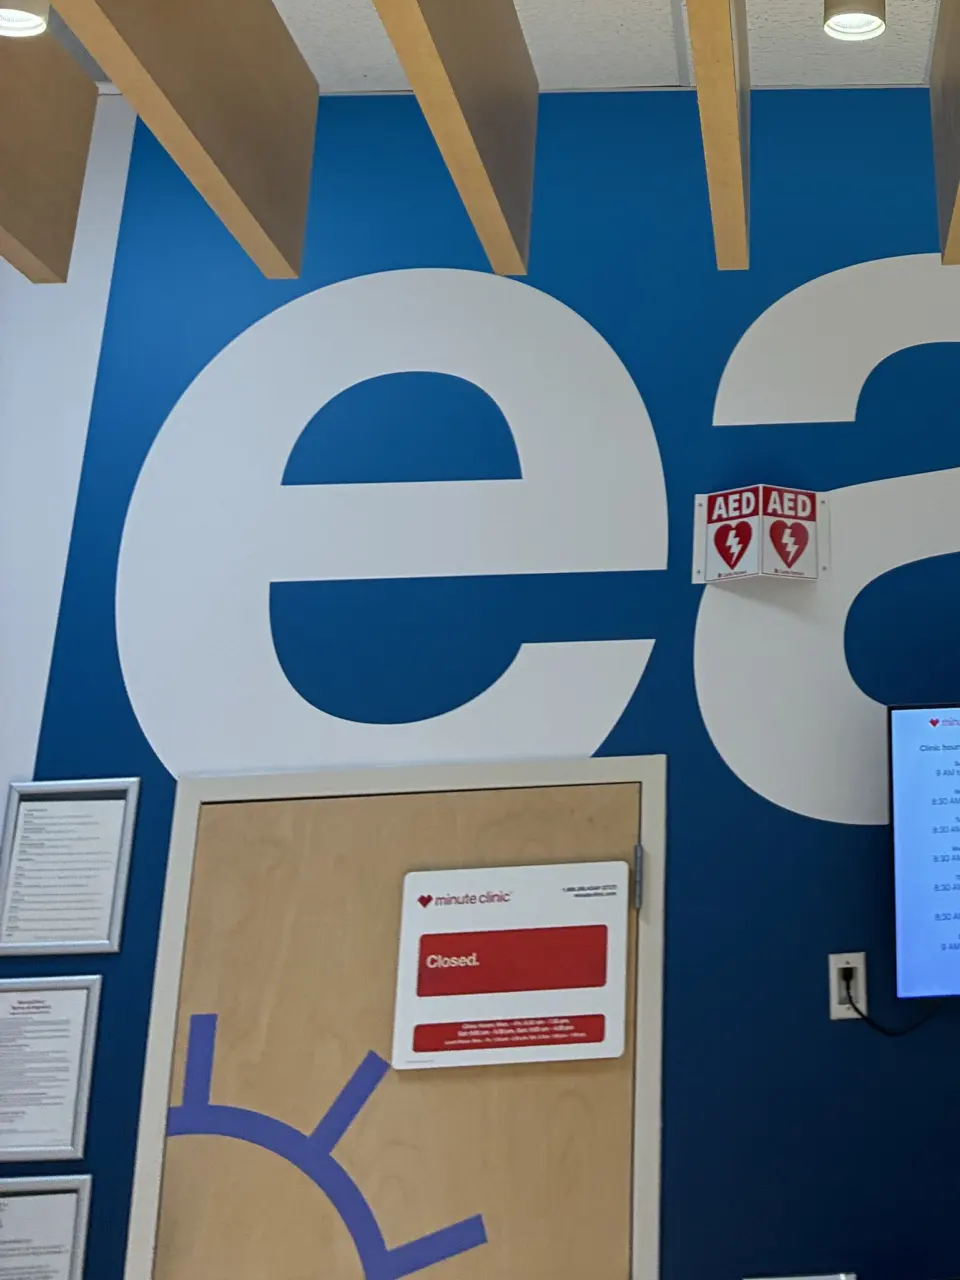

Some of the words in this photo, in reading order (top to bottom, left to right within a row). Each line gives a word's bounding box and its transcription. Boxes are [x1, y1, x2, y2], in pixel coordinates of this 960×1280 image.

[712, 491, 756, 520] AED
[767, 491, 812, 517] AED
[919, 744, 941, 752] Clinic
[434, 893, 477, 907] minute
[479, 890, 511, 904] clinic
[426, 952, 480, 969] Closed.
